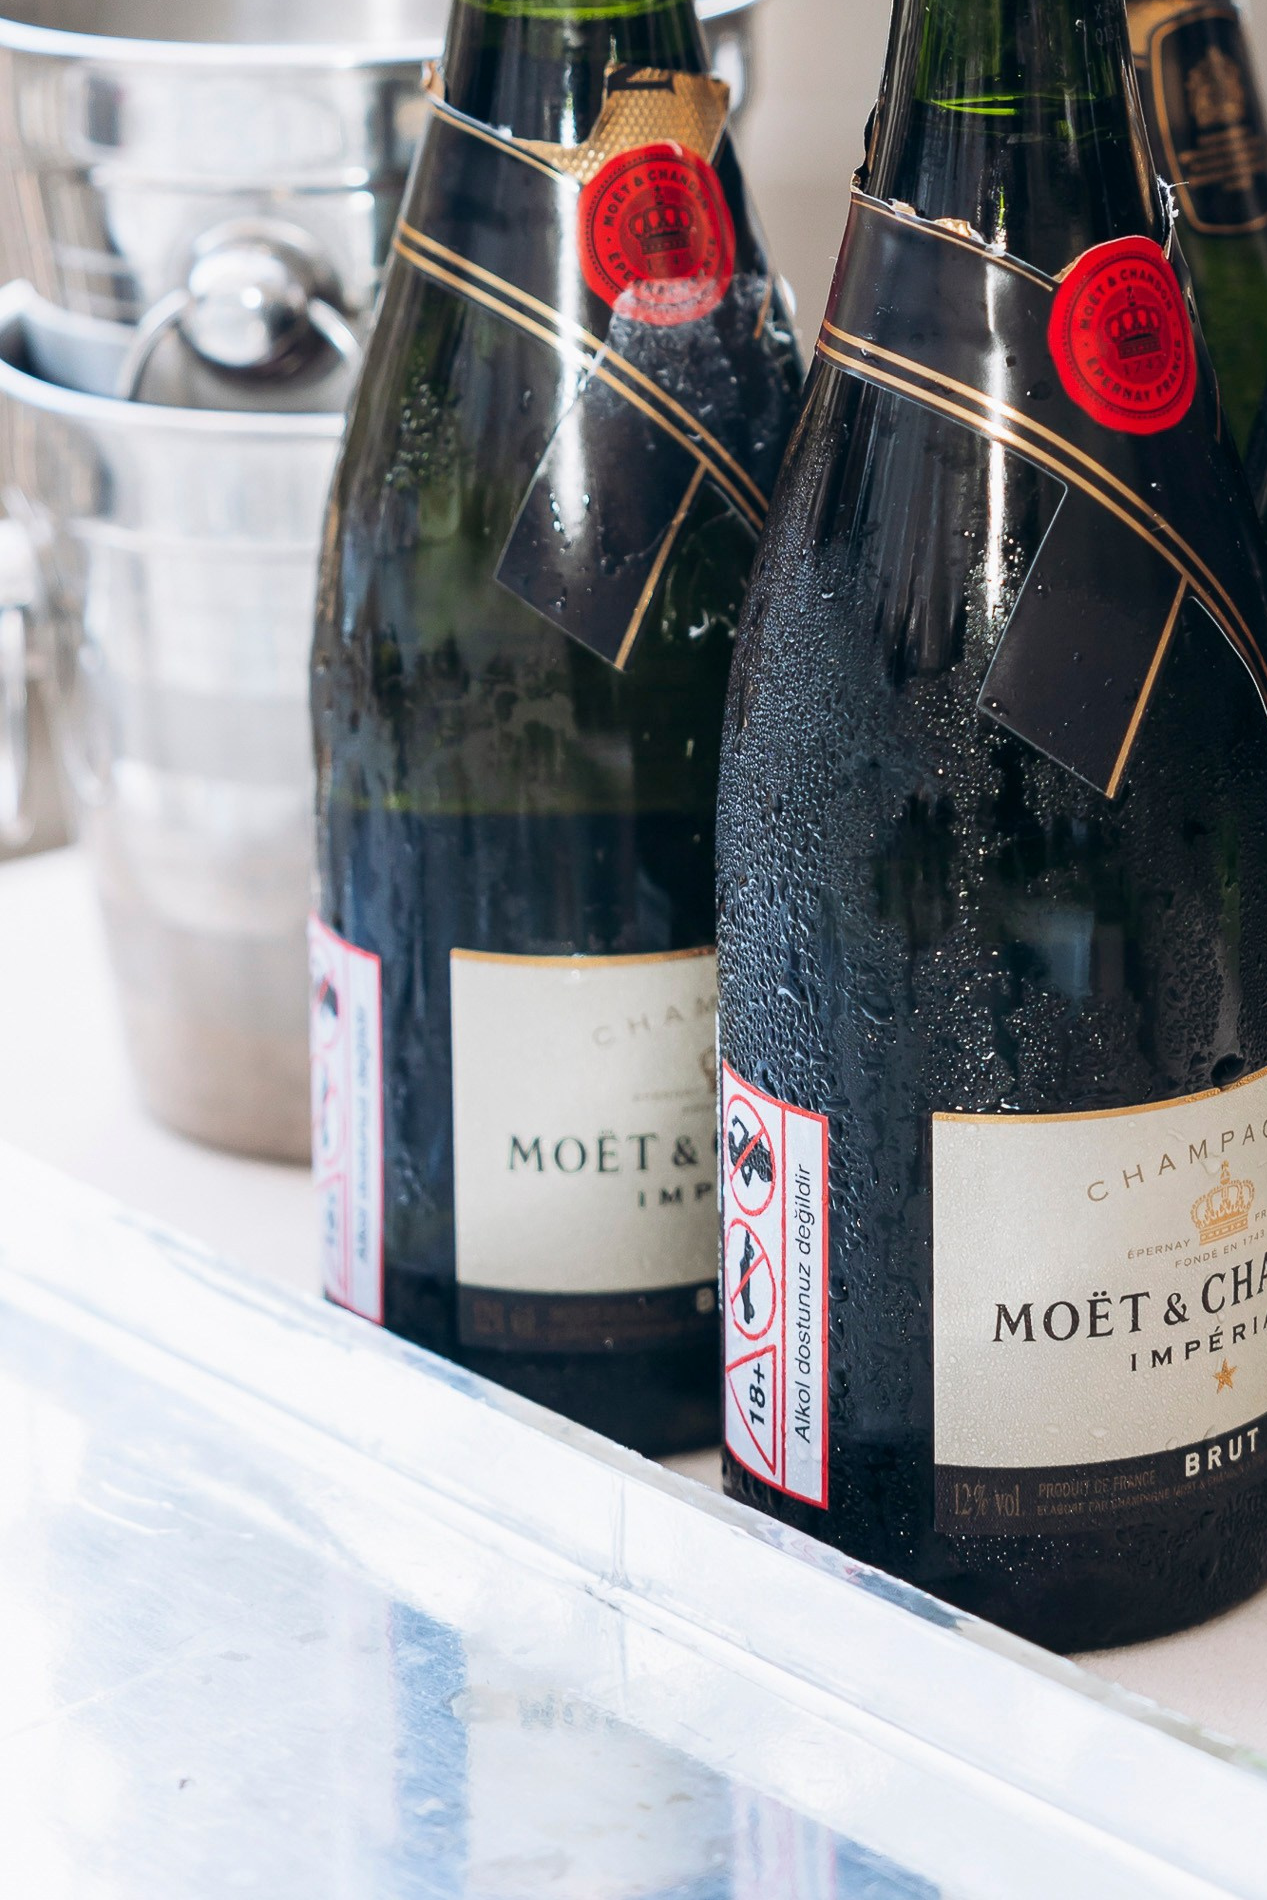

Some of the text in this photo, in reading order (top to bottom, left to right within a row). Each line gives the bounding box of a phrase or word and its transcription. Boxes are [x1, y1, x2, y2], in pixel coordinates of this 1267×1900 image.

[507, 1130, 698, 1174] MOËT &
[1126, 1237, 1192, 1260] ÉPERNAY
[1174, 1228, 1266, 1269] FONDÉ EN 1743
[795, 1164, 817, 1445] Alkol dostunuz değildir
[992, 1290, 1151, 1343] MOËT
[1162, 1292, 1191, 1326] &
[748, 1362, 767, 1427] 18+
[1184, 1427, 1260, 1478] BRUT
[1112, 1469, 1157, 1492] FRANCE
